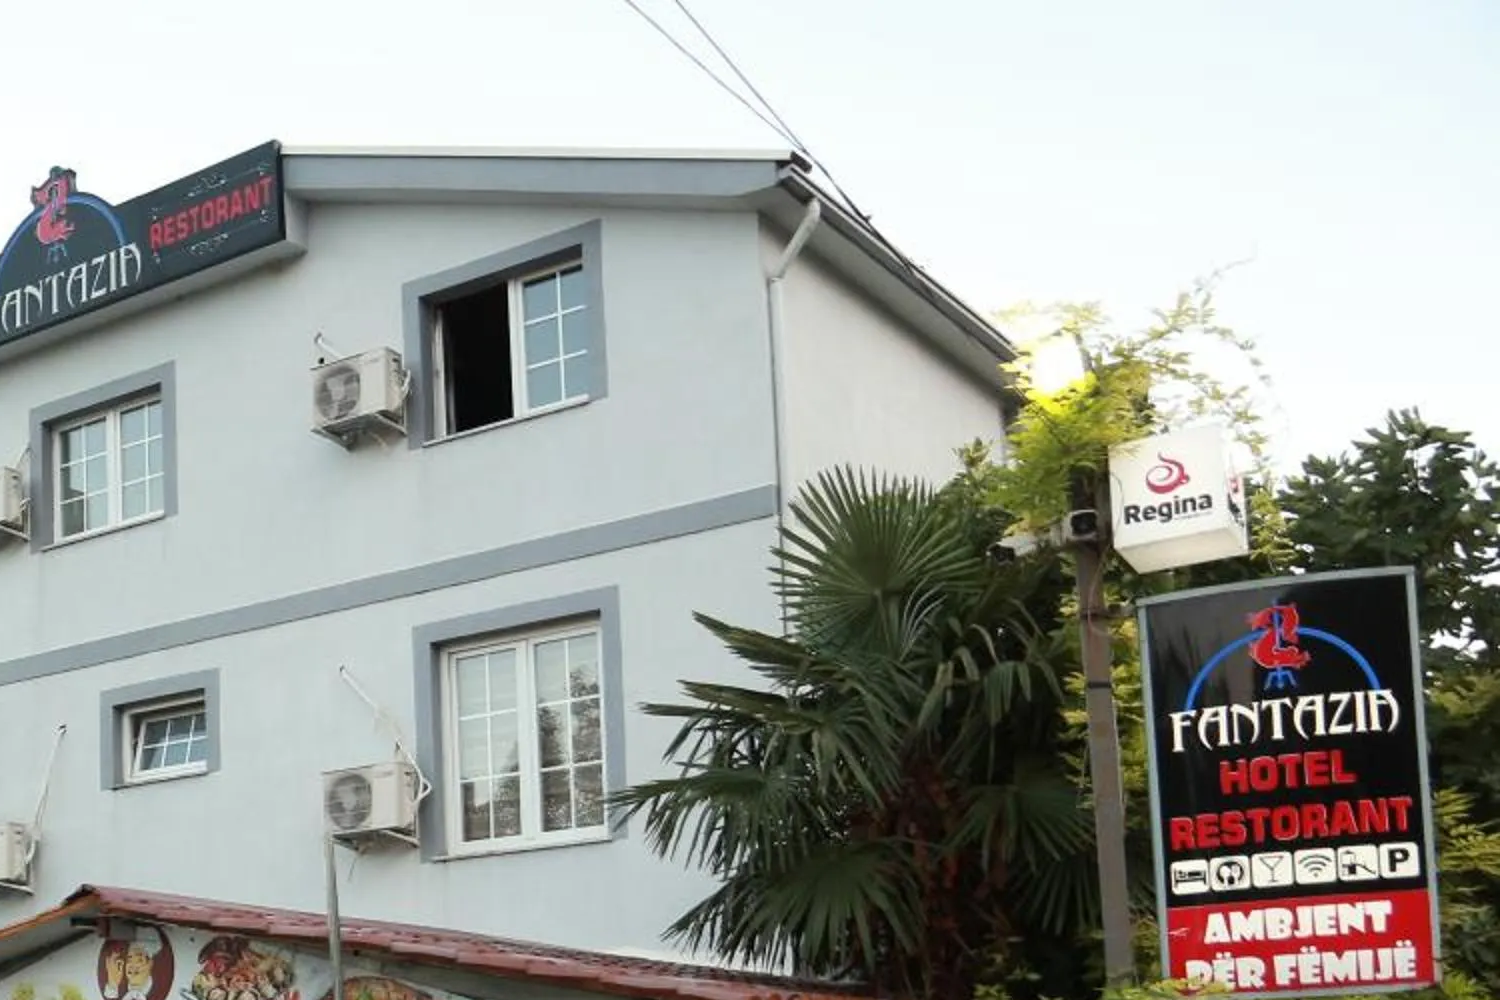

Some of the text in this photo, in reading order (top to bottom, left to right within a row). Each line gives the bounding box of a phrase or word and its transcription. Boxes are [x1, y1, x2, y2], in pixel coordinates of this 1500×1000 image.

[150, 175, 274, 250] RESTORANT
[1124, 494, 1213, 525] Regina
[1170, 689, 1400, 752] FANTAZIA
[1220, 750, 1356, 795] HOTEL
[1171, 797, 1412, 849] RESTORANT
[1204, 900, 1392, 944] AMBJENT
[1186, 939, 1417, 990] PËR FËMIJË
